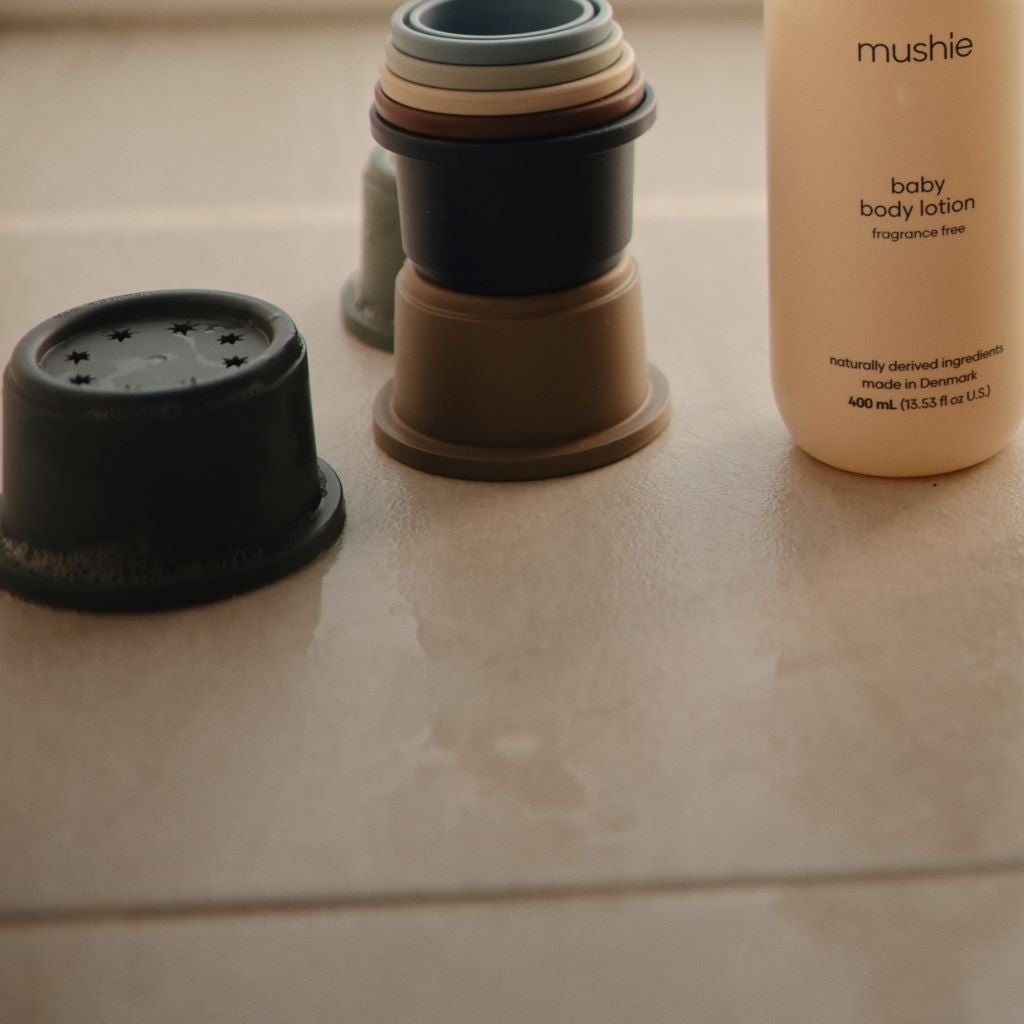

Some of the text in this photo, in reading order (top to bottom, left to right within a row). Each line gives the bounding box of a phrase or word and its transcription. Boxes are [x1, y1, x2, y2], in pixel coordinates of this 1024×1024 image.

[857, 32, 973, 63] mushie
[891, 176, 946, 196] baby
[860, 197, 975, 222] body lotion
[872, 225, 966, 242] fragrance free
[830, 343, 1004, 373] naturally derived ingredients
[862, 370, 977, 389] made in Denmark
[848, 385, 991, 411] 400 mL (13.53 fl oz U.S.)
